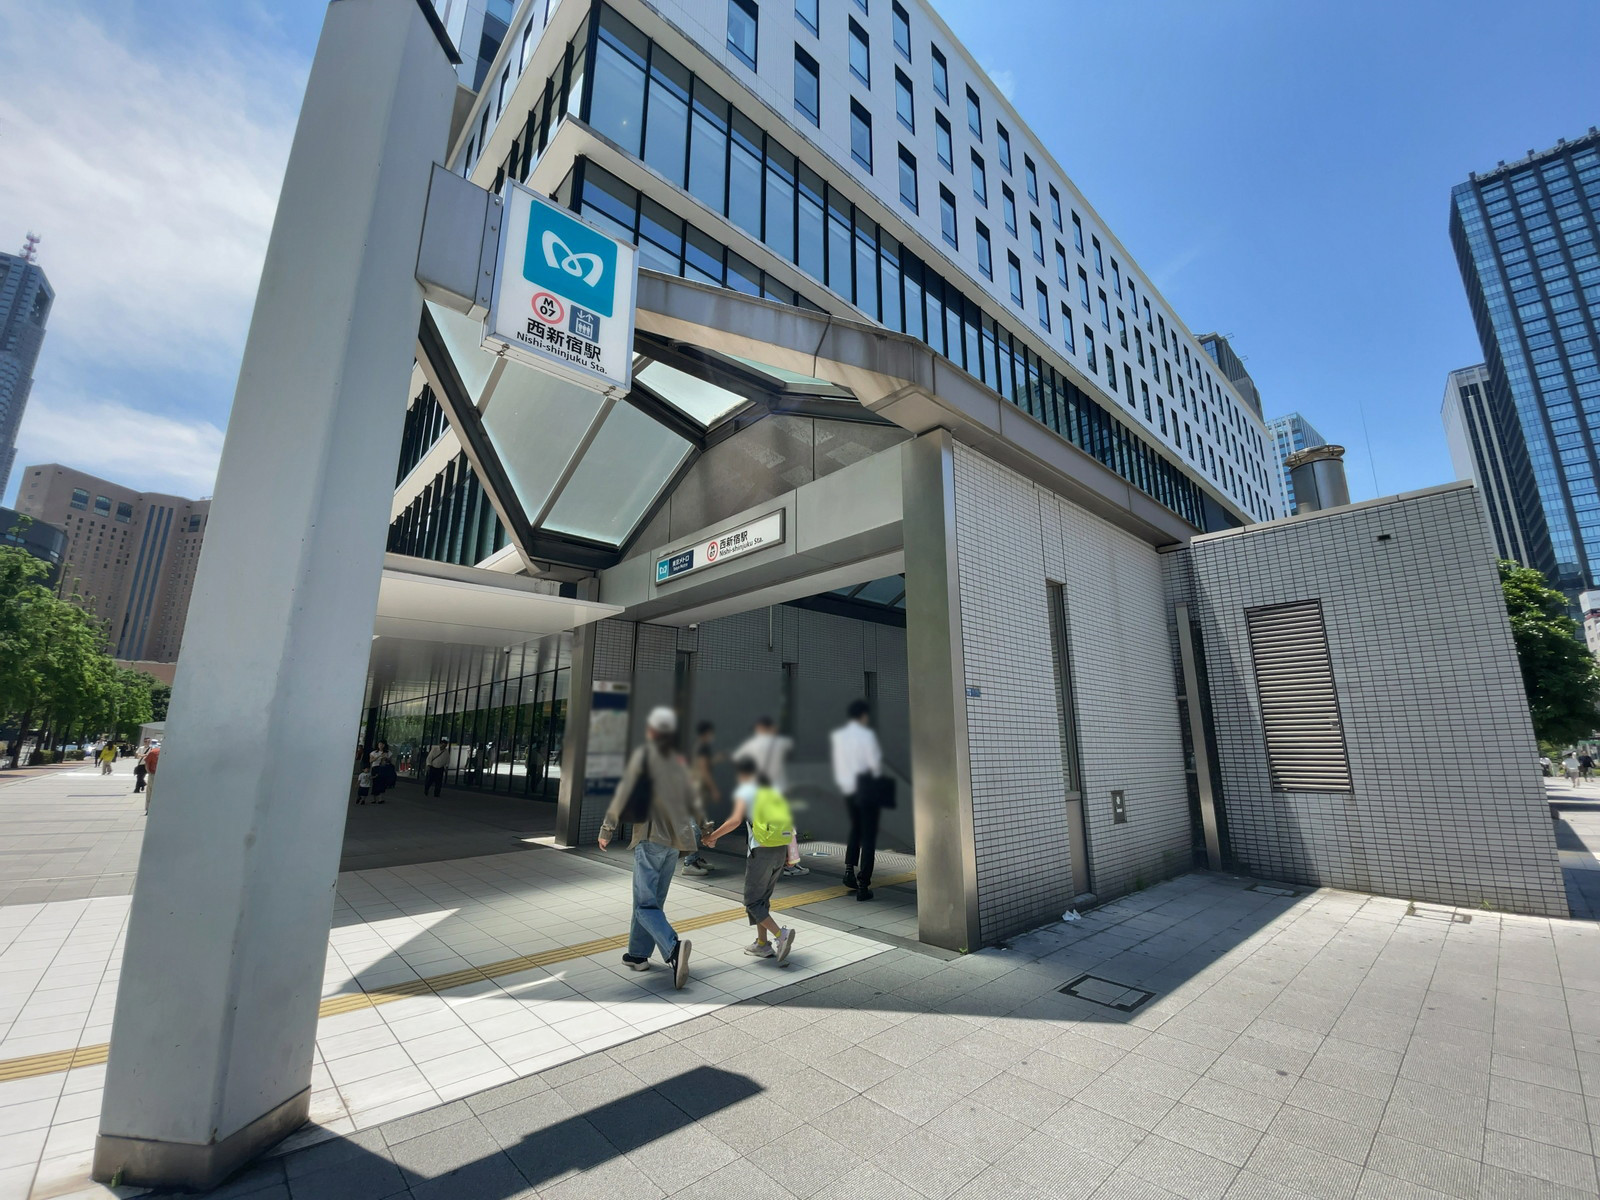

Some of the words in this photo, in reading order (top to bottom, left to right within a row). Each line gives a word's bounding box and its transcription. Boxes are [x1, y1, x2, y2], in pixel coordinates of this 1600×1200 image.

[543, 298, 554, 308] M
[540, 305, 556, 317] 07
[527, 317, 602, 362] 西新宿駅
[516, 331, 588, 366] Nishi-shinjuku
[590, 361, 607, 374] Sta.
[719, 531, 748, 550] 西新宿駅
[754, 537, 763, 545] Sta.
